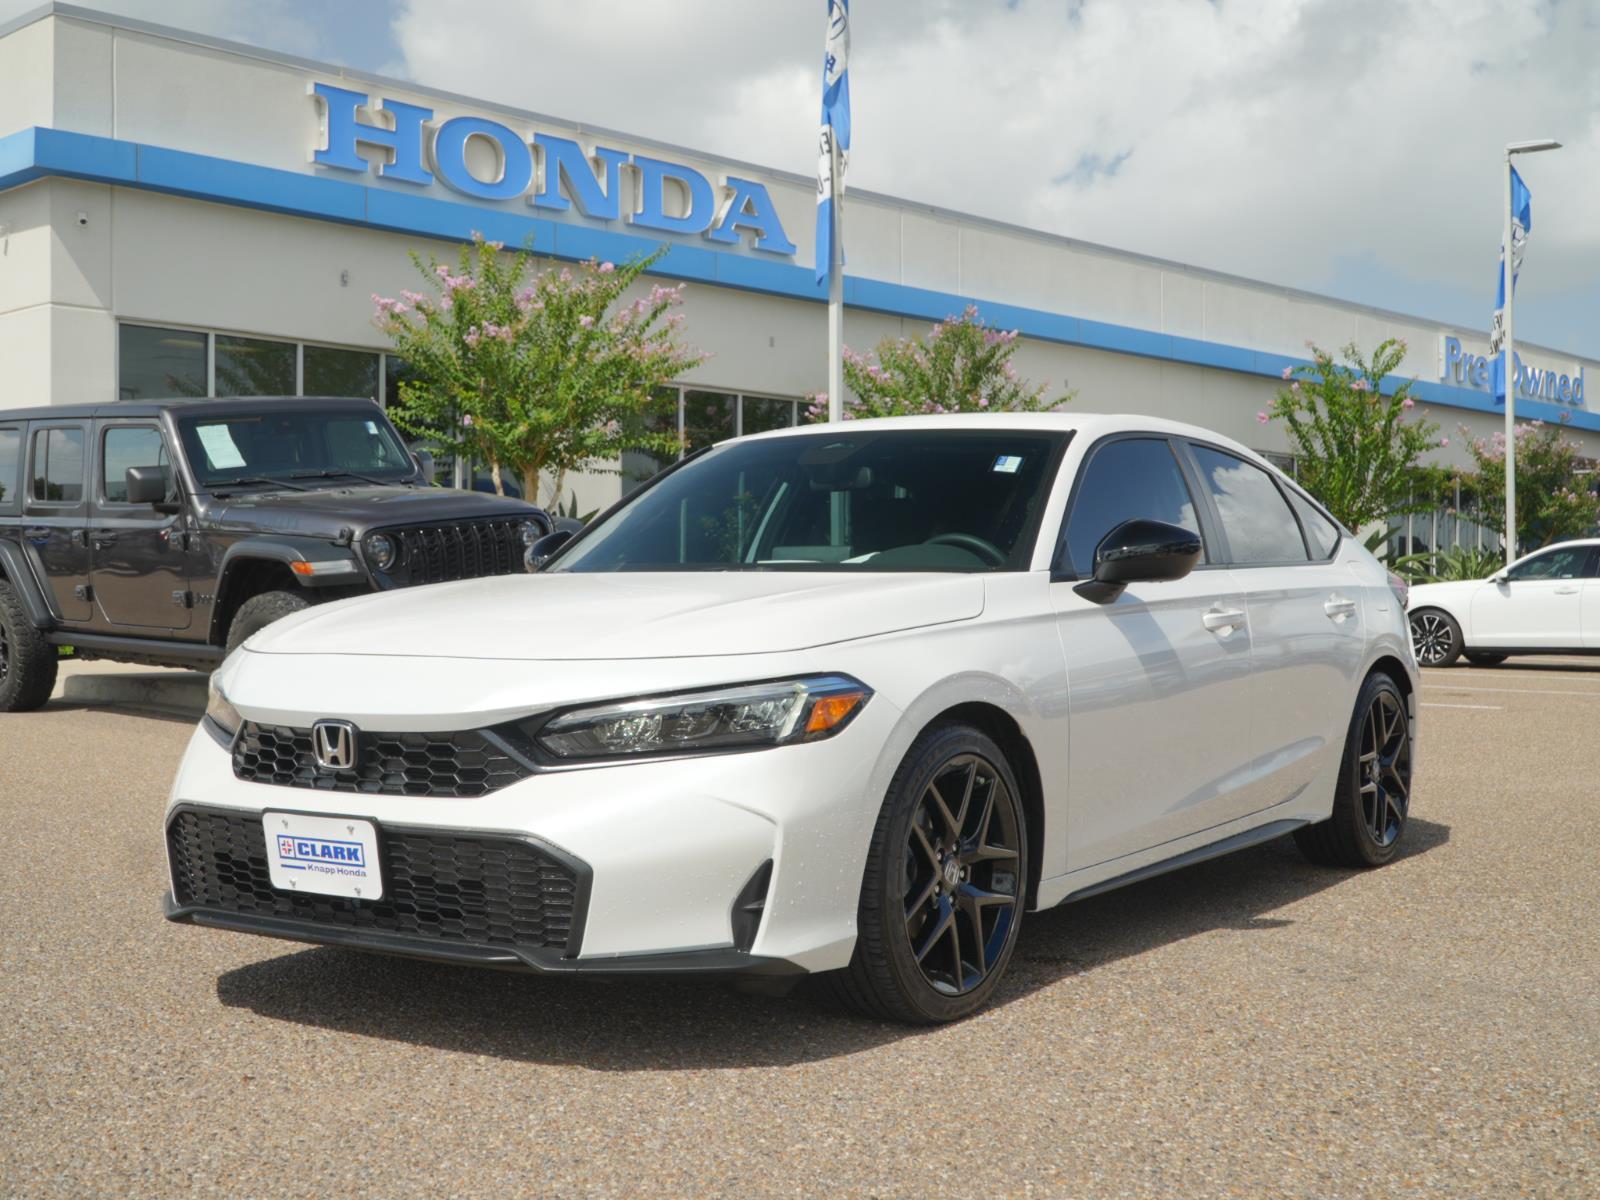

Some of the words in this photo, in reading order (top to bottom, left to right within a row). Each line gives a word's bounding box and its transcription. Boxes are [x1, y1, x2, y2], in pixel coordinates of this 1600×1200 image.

[311, 82, 796, 256] HONDA
[297, 842, 360, 862] CLARK
[307, 863, 336, 875] Knapp
[337, 867, 367, 877] Honda
